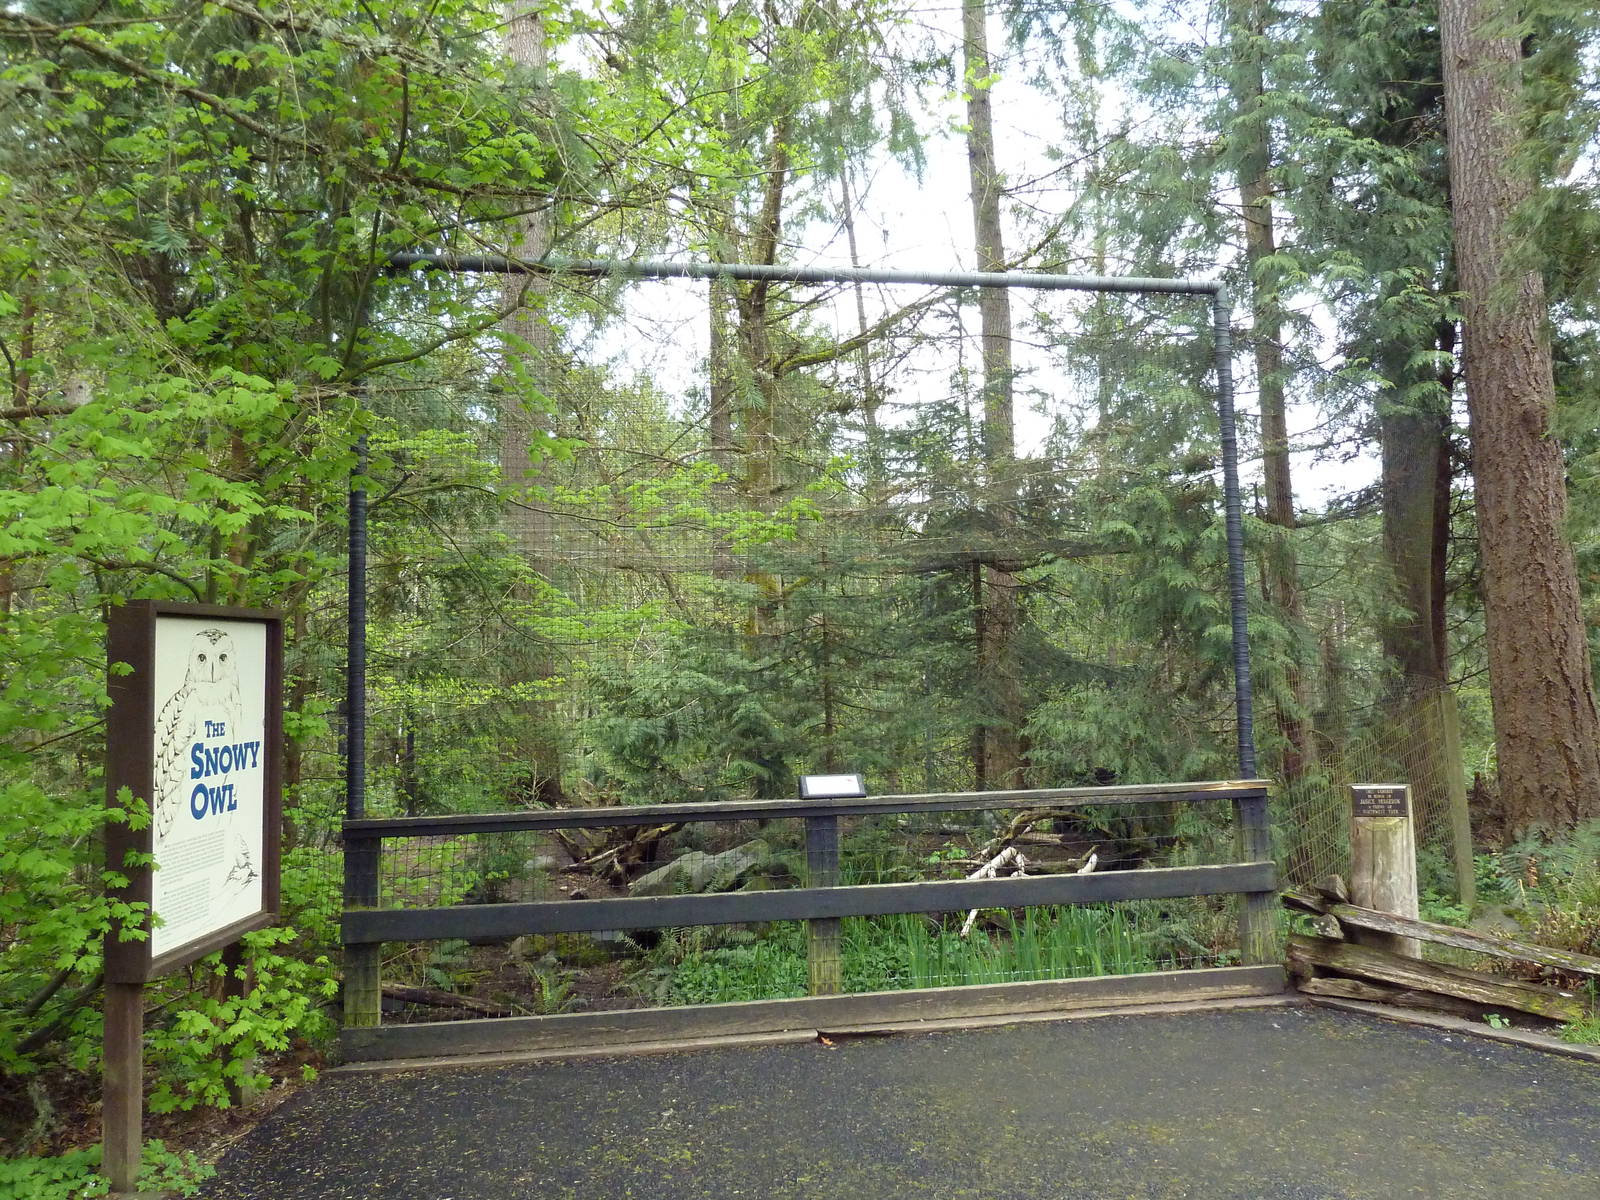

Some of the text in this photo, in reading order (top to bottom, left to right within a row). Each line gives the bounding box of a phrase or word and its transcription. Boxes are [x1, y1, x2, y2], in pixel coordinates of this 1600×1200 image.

[205, 720, 225, 738] THE
[191, 741, 260, 779] SNOWY
[191, 783, 237, 820] OWL
